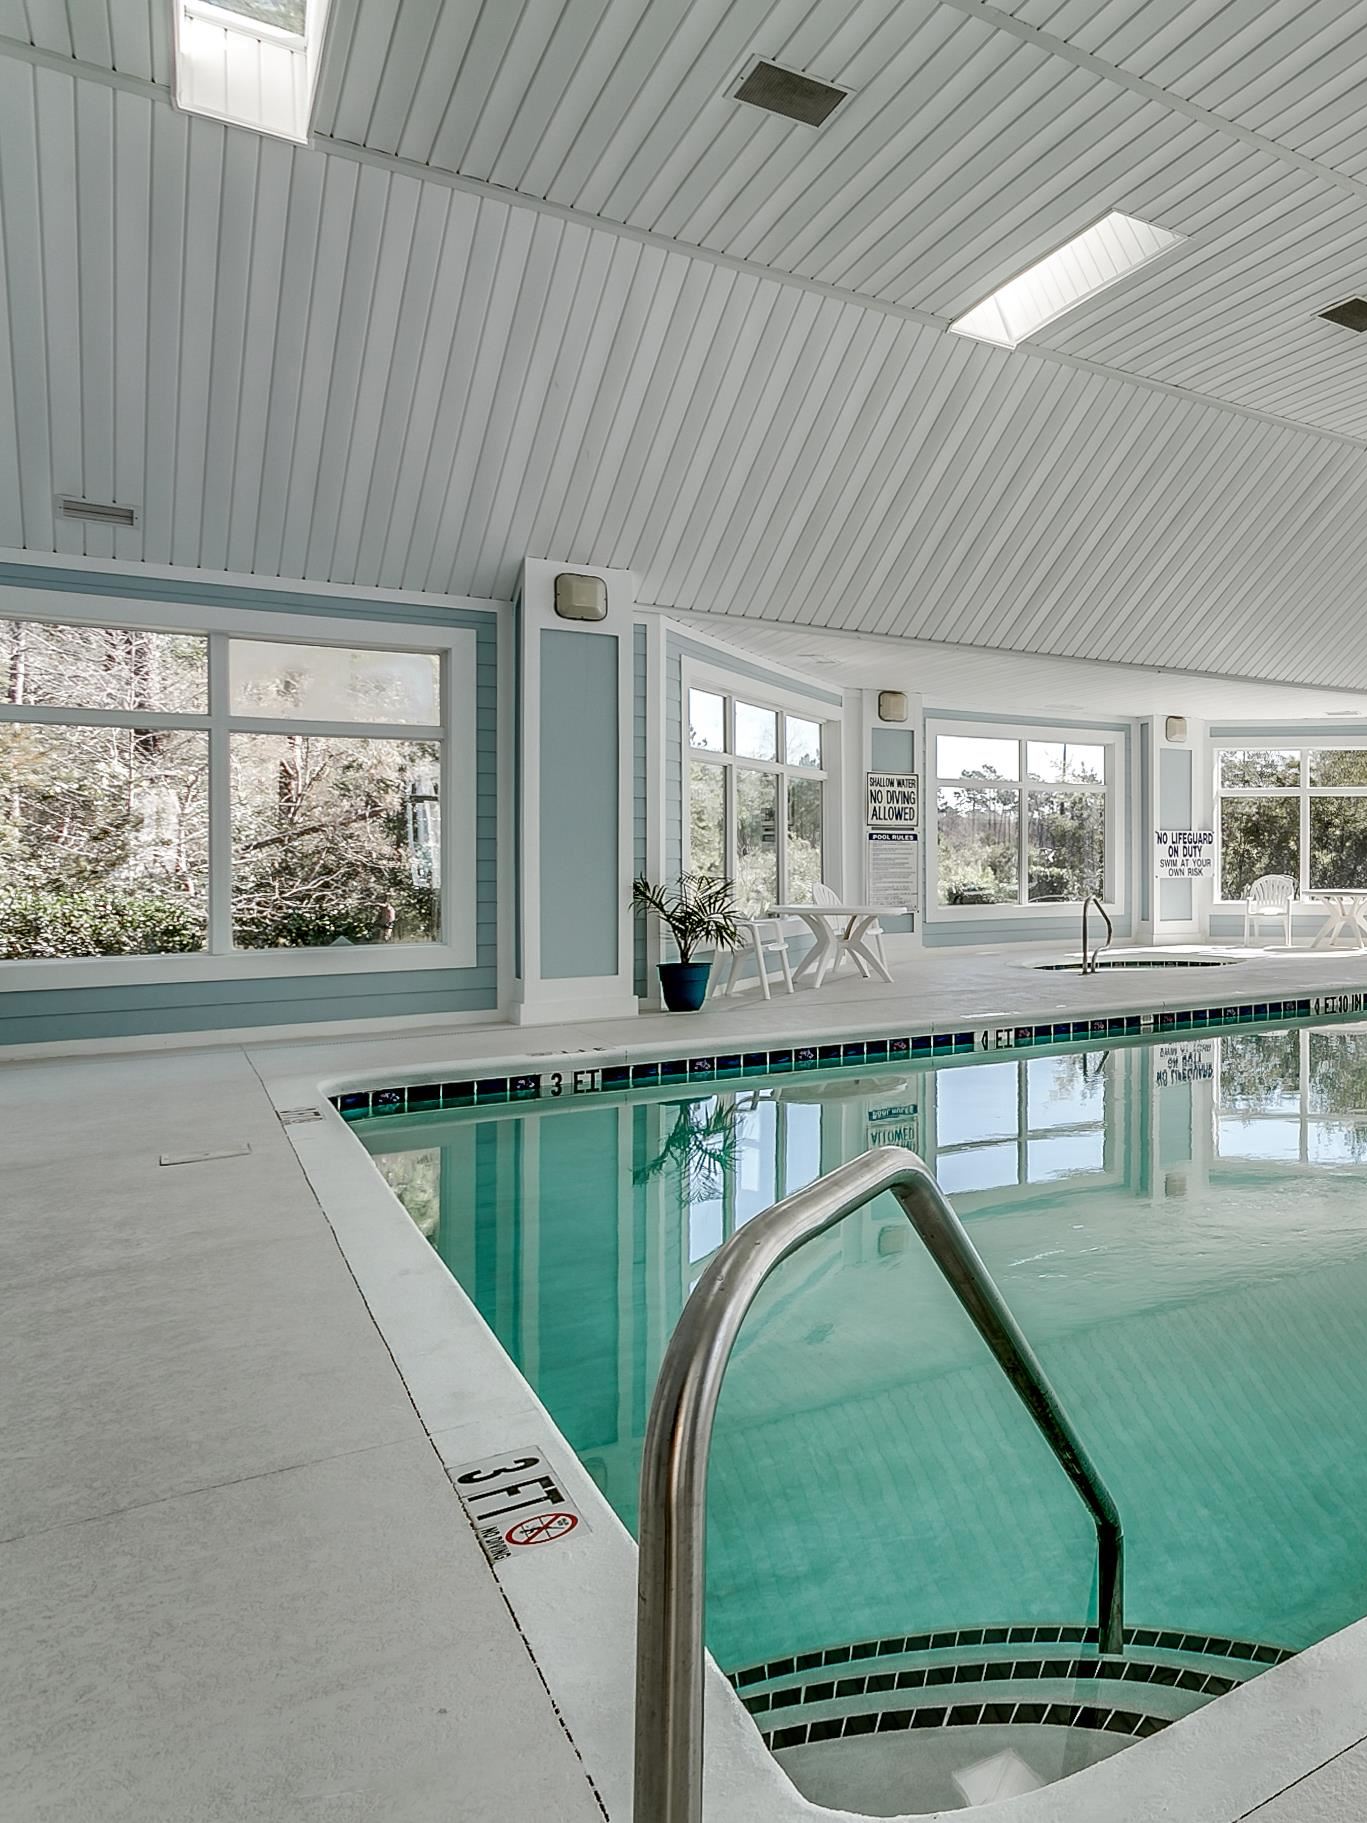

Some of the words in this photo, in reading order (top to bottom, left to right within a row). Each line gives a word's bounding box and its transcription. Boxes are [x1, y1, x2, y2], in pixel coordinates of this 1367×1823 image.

[869, 777, 894, 787] SHALLOW
[896, 779, 916, 789] WATER
[870, 790, 883, 804] NO
[886, 790, 916, 805] DIVING
[871, 807, 915, 821] ALLOWED
[1157, 832, 1168, 844] NO
[1172, 833, 1213, 844] LIFEGUARD
[1168, 846, 1179, 857] ON
[1182, 846, 1202, 857] DUTY
[1160, 859, 1178, 868] SWIM
[1180, 859, 1189, 867] AT
[1192, 859, 1211, 868] YOUR
[1169, 868, 1185, 877] OWN
[1187, 868, 1203, 876] RISK
[457, 1457, 540, 1484] 3
[467, 1475, 565, 1521] FT
